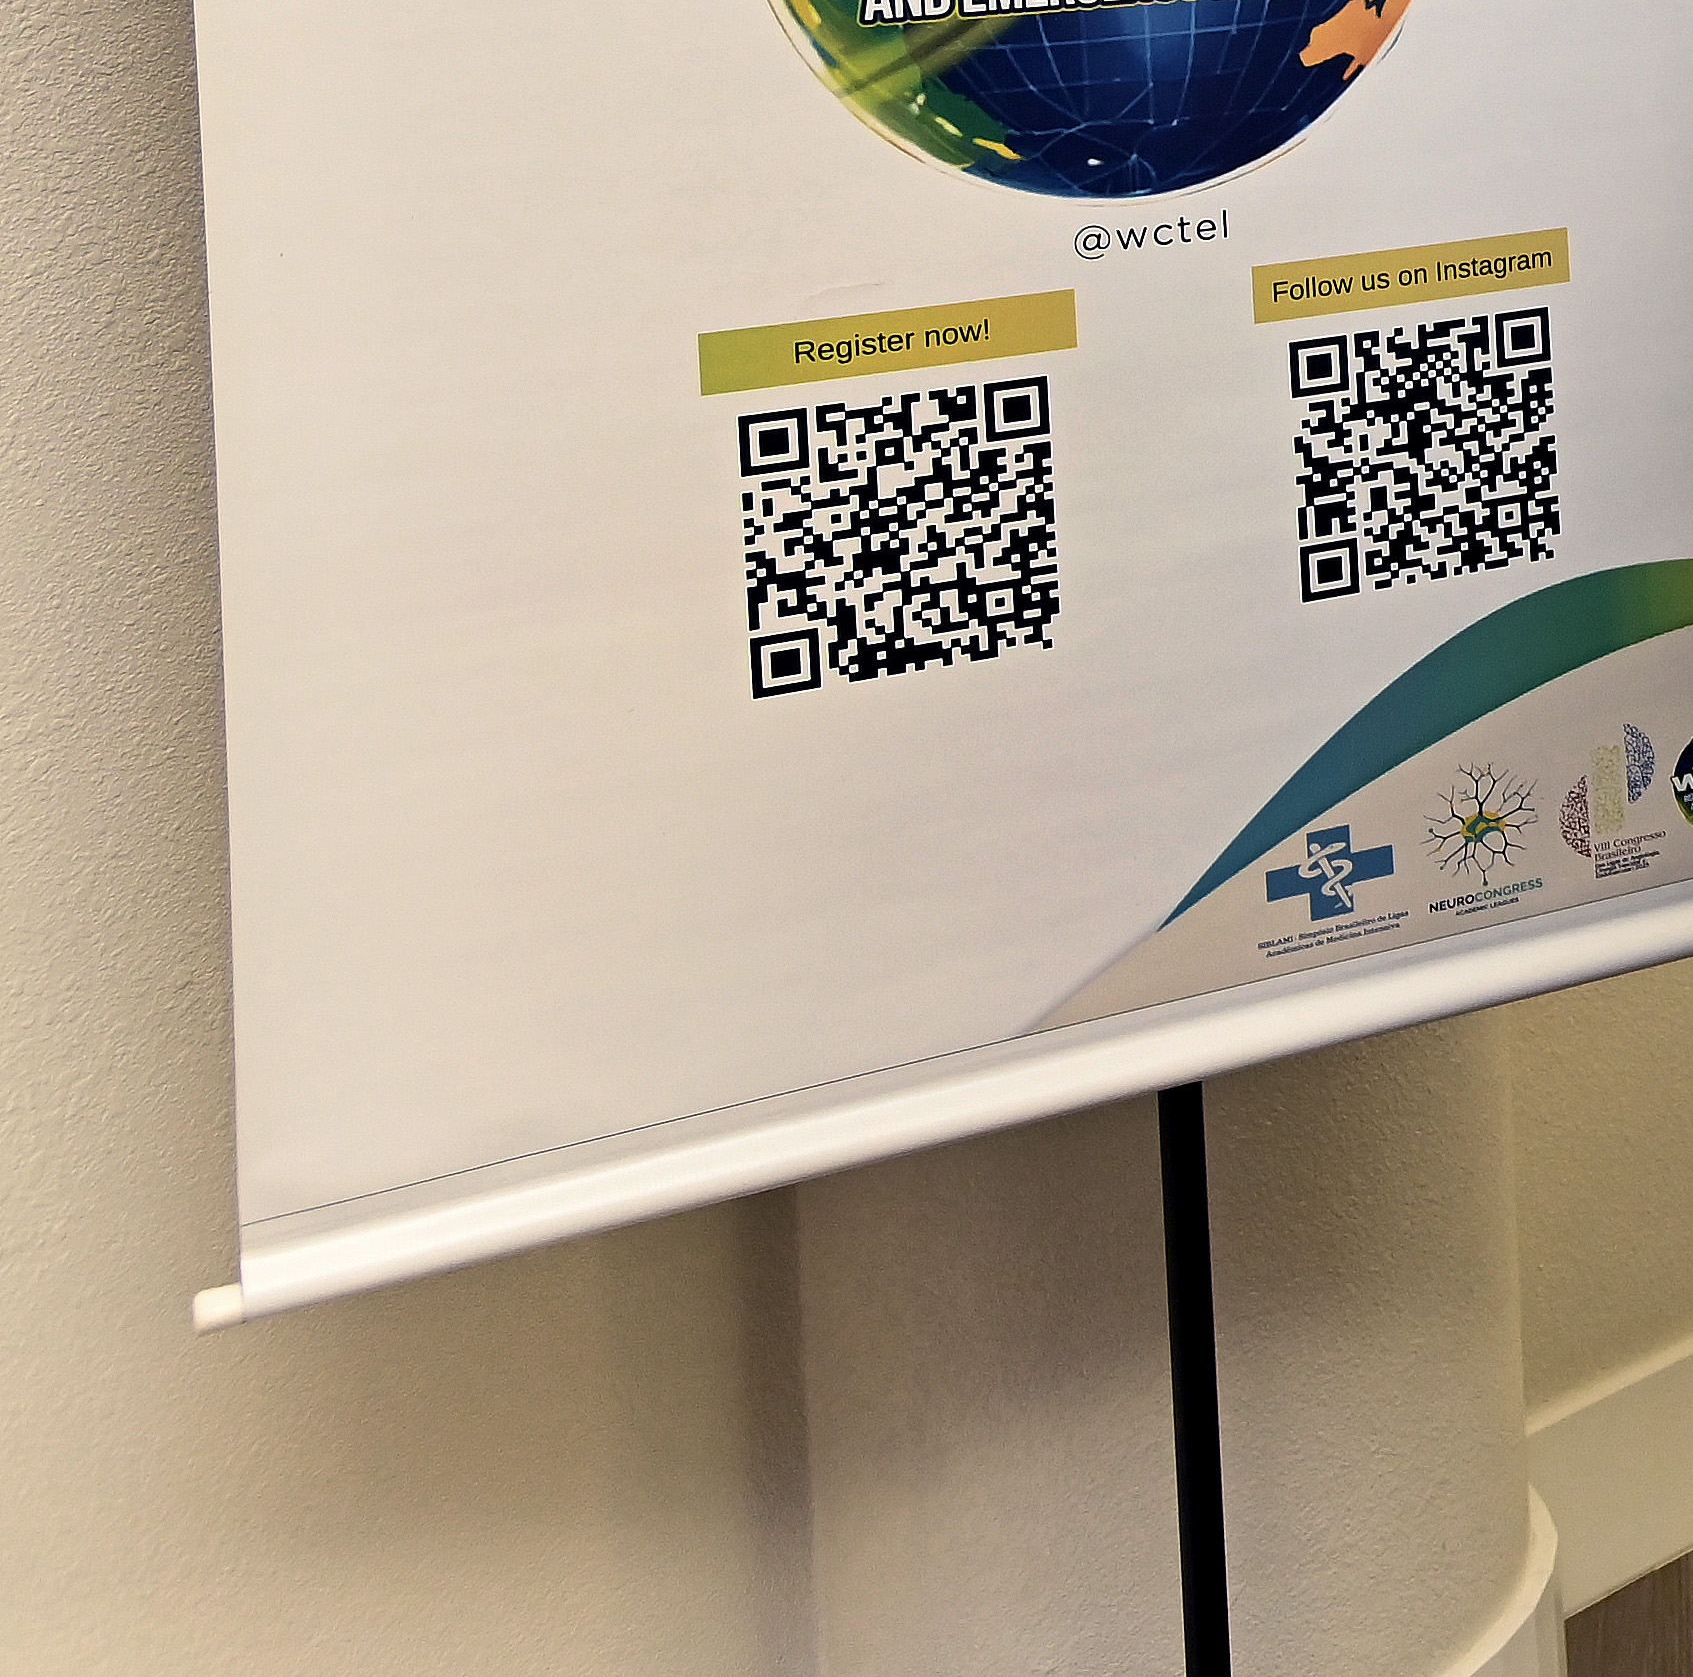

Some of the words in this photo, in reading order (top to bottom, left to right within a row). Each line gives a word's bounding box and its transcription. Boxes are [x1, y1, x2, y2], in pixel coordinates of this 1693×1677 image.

[1074, 209, 1228, 260] @wctel
[1272, 276, 1354, 303] Follow
[1361, 272, 1390, 292] us
[1398, 267, 1428, 287] on
[1436, 251, 1552, 282] Instagram
[794, 332, 915, 365] Register
[924, 318, 989, 348] now!
[1429, 878, 1543, 914] NEUROCONGRESS
